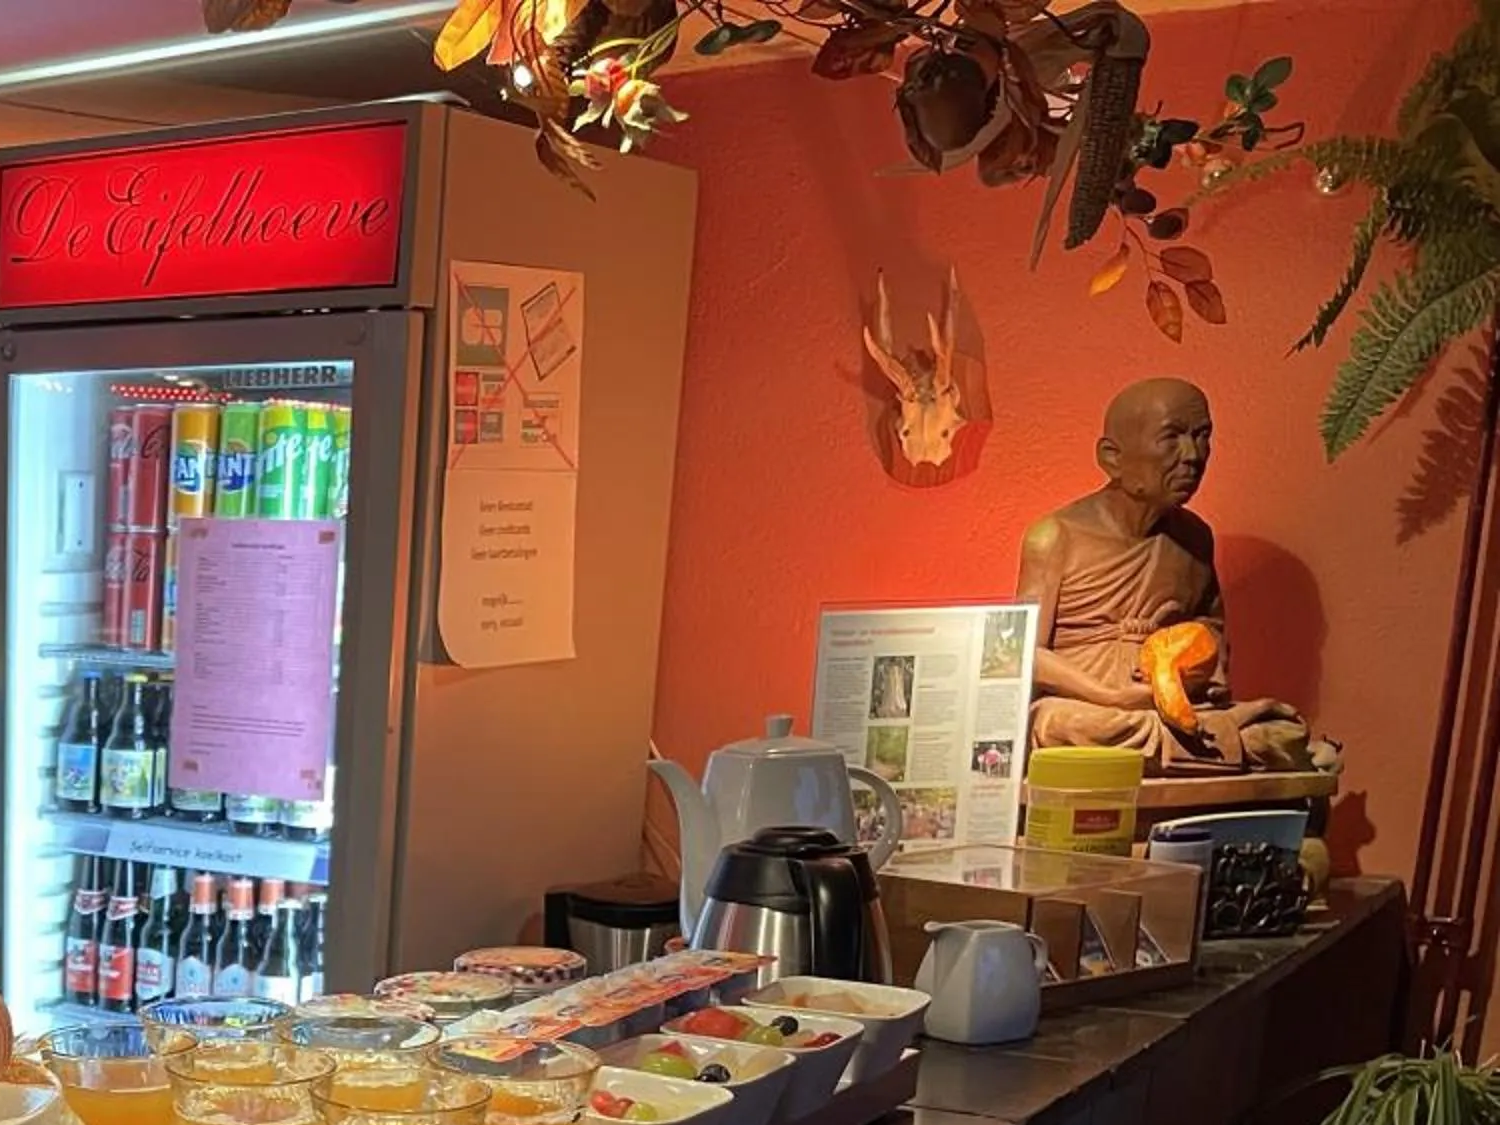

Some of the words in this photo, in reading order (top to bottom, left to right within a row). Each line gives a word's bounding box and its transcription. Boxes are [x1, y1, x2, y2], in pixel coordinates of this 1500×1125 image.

[8, 174, 92, 264] De
[104, 164, 390, 288] Eifelhoeve
[222, 364, 337, 388] LIEBHERR
[175, 455, 214, 478] ANT
[218, 452, 255, 477] ANT
